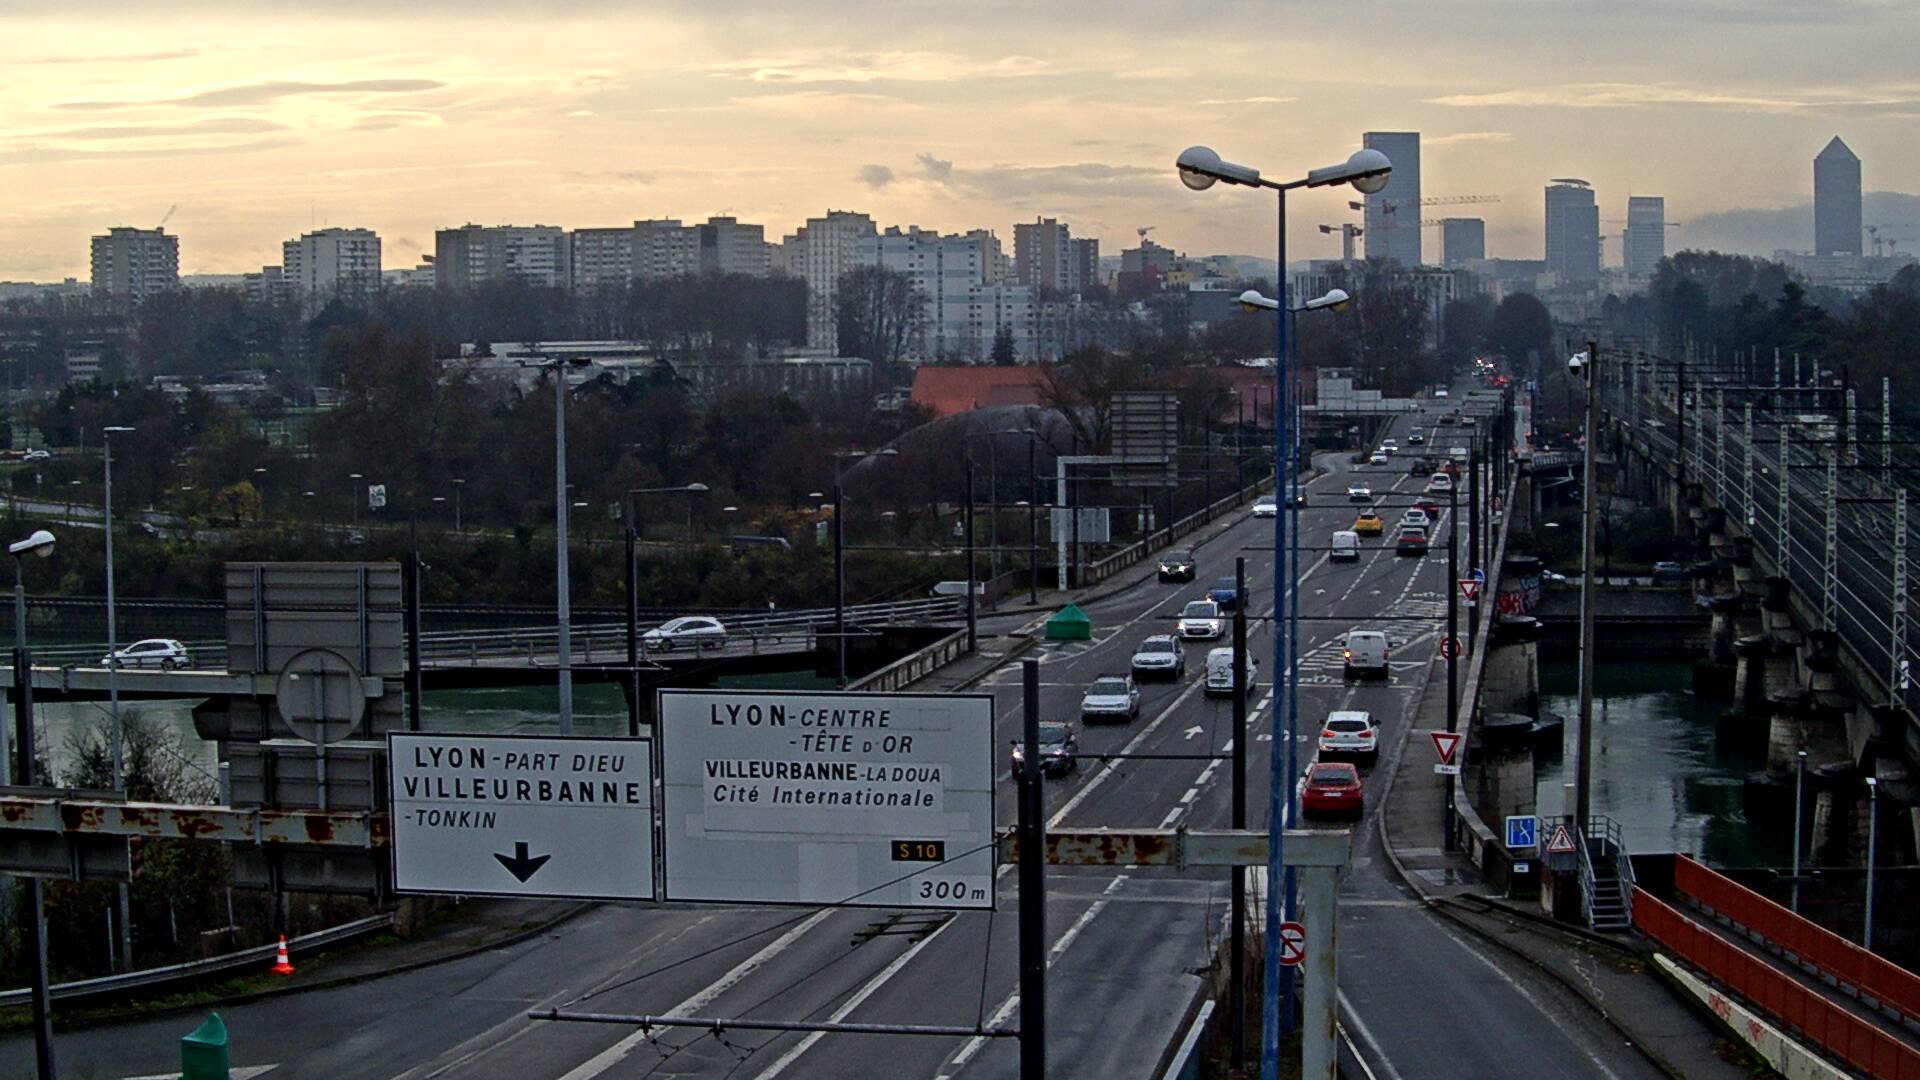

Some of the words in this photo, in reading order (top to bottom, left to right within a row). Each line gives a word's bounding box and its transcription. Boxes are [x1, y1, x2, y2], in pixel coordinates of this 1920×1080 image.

[572, 754, 625, 773] DIEU
[892, 767, 941, 783] DOUA
[404, 776, 639, 804] VILLEURBANNE
[713, 784, 759, 803] Cité
[772, 785, 934, 807] Internationale
[900, 843, 909, 858] S
[916, 844, 936, 858] 10
